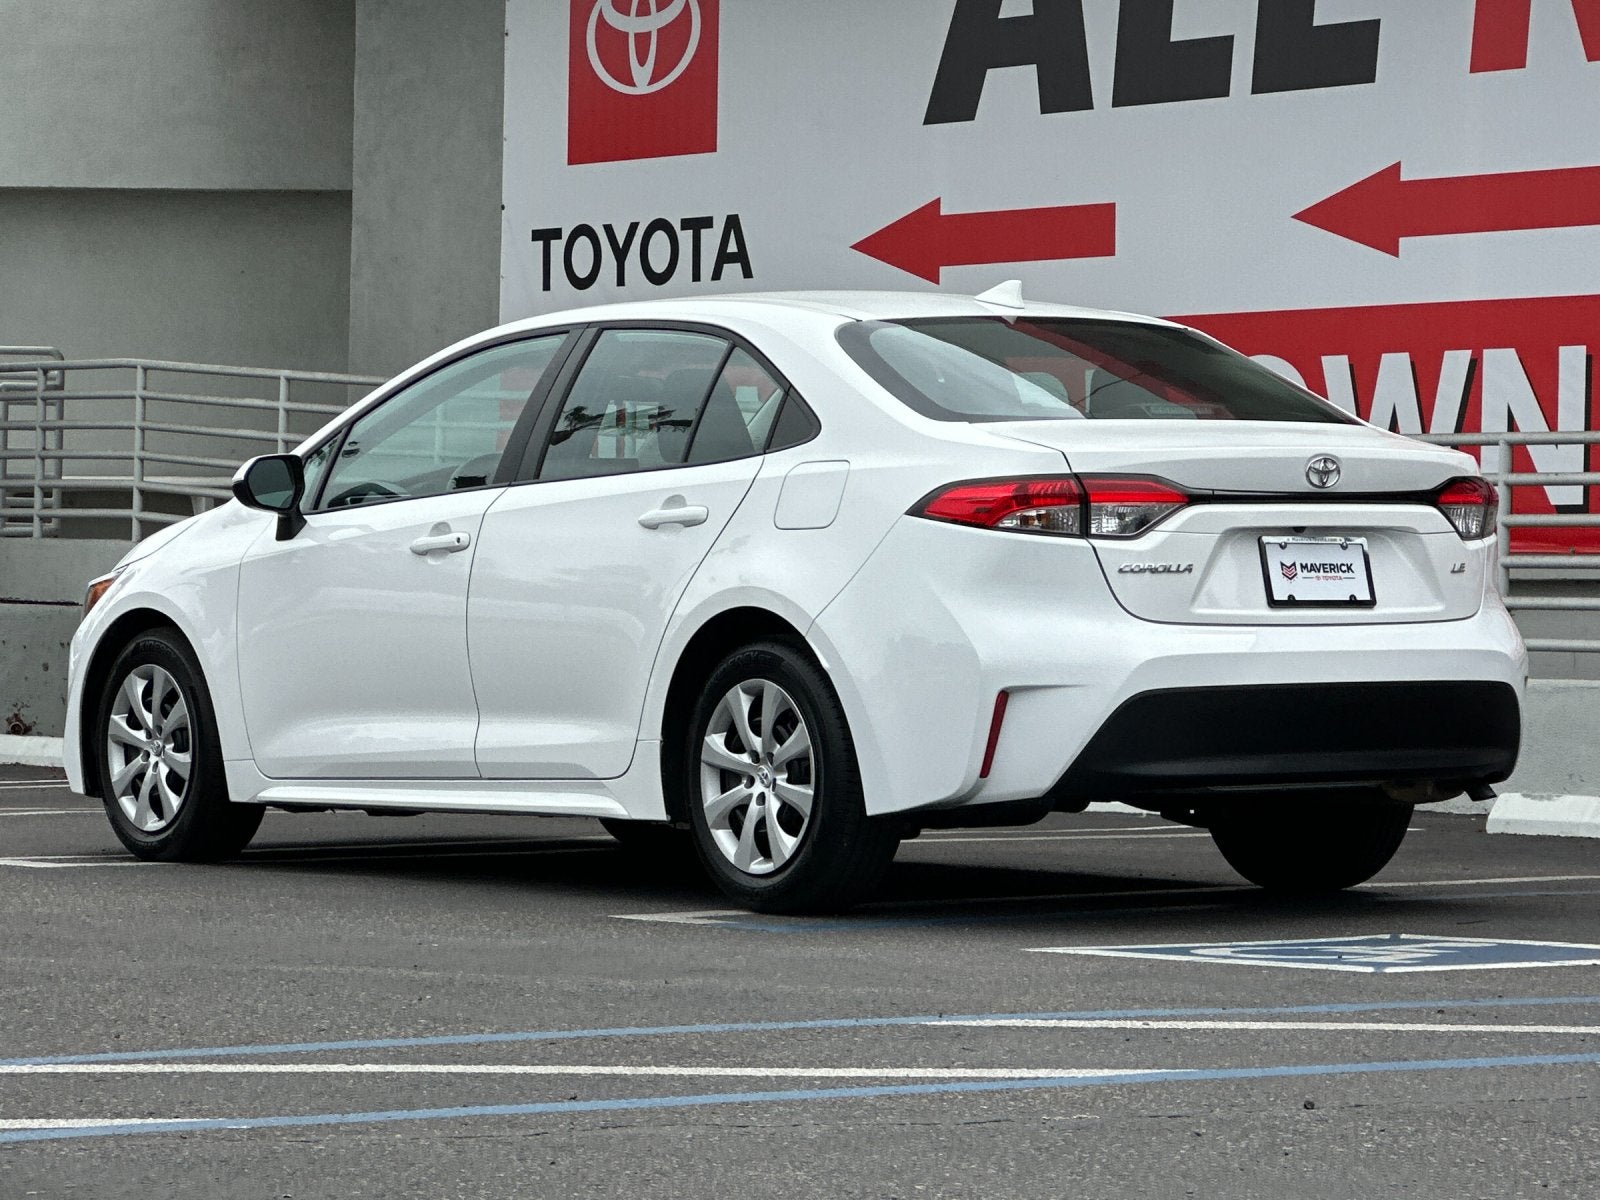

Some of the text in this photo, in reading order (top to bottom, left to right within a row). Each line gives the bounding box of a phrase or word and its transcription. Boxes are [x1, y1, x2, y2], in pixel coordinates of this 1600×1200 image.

[531, 213, 754, 292] TOYOTA
[1248, 344, 1588, 506] WN
[1117, 562, 1194, 574] COROLLA
[1299, 562, 1355, 574] MAVERICK
[1450, 562, 1466, 574] LE
[1321, 574, 1344, 582] TOYOTA
